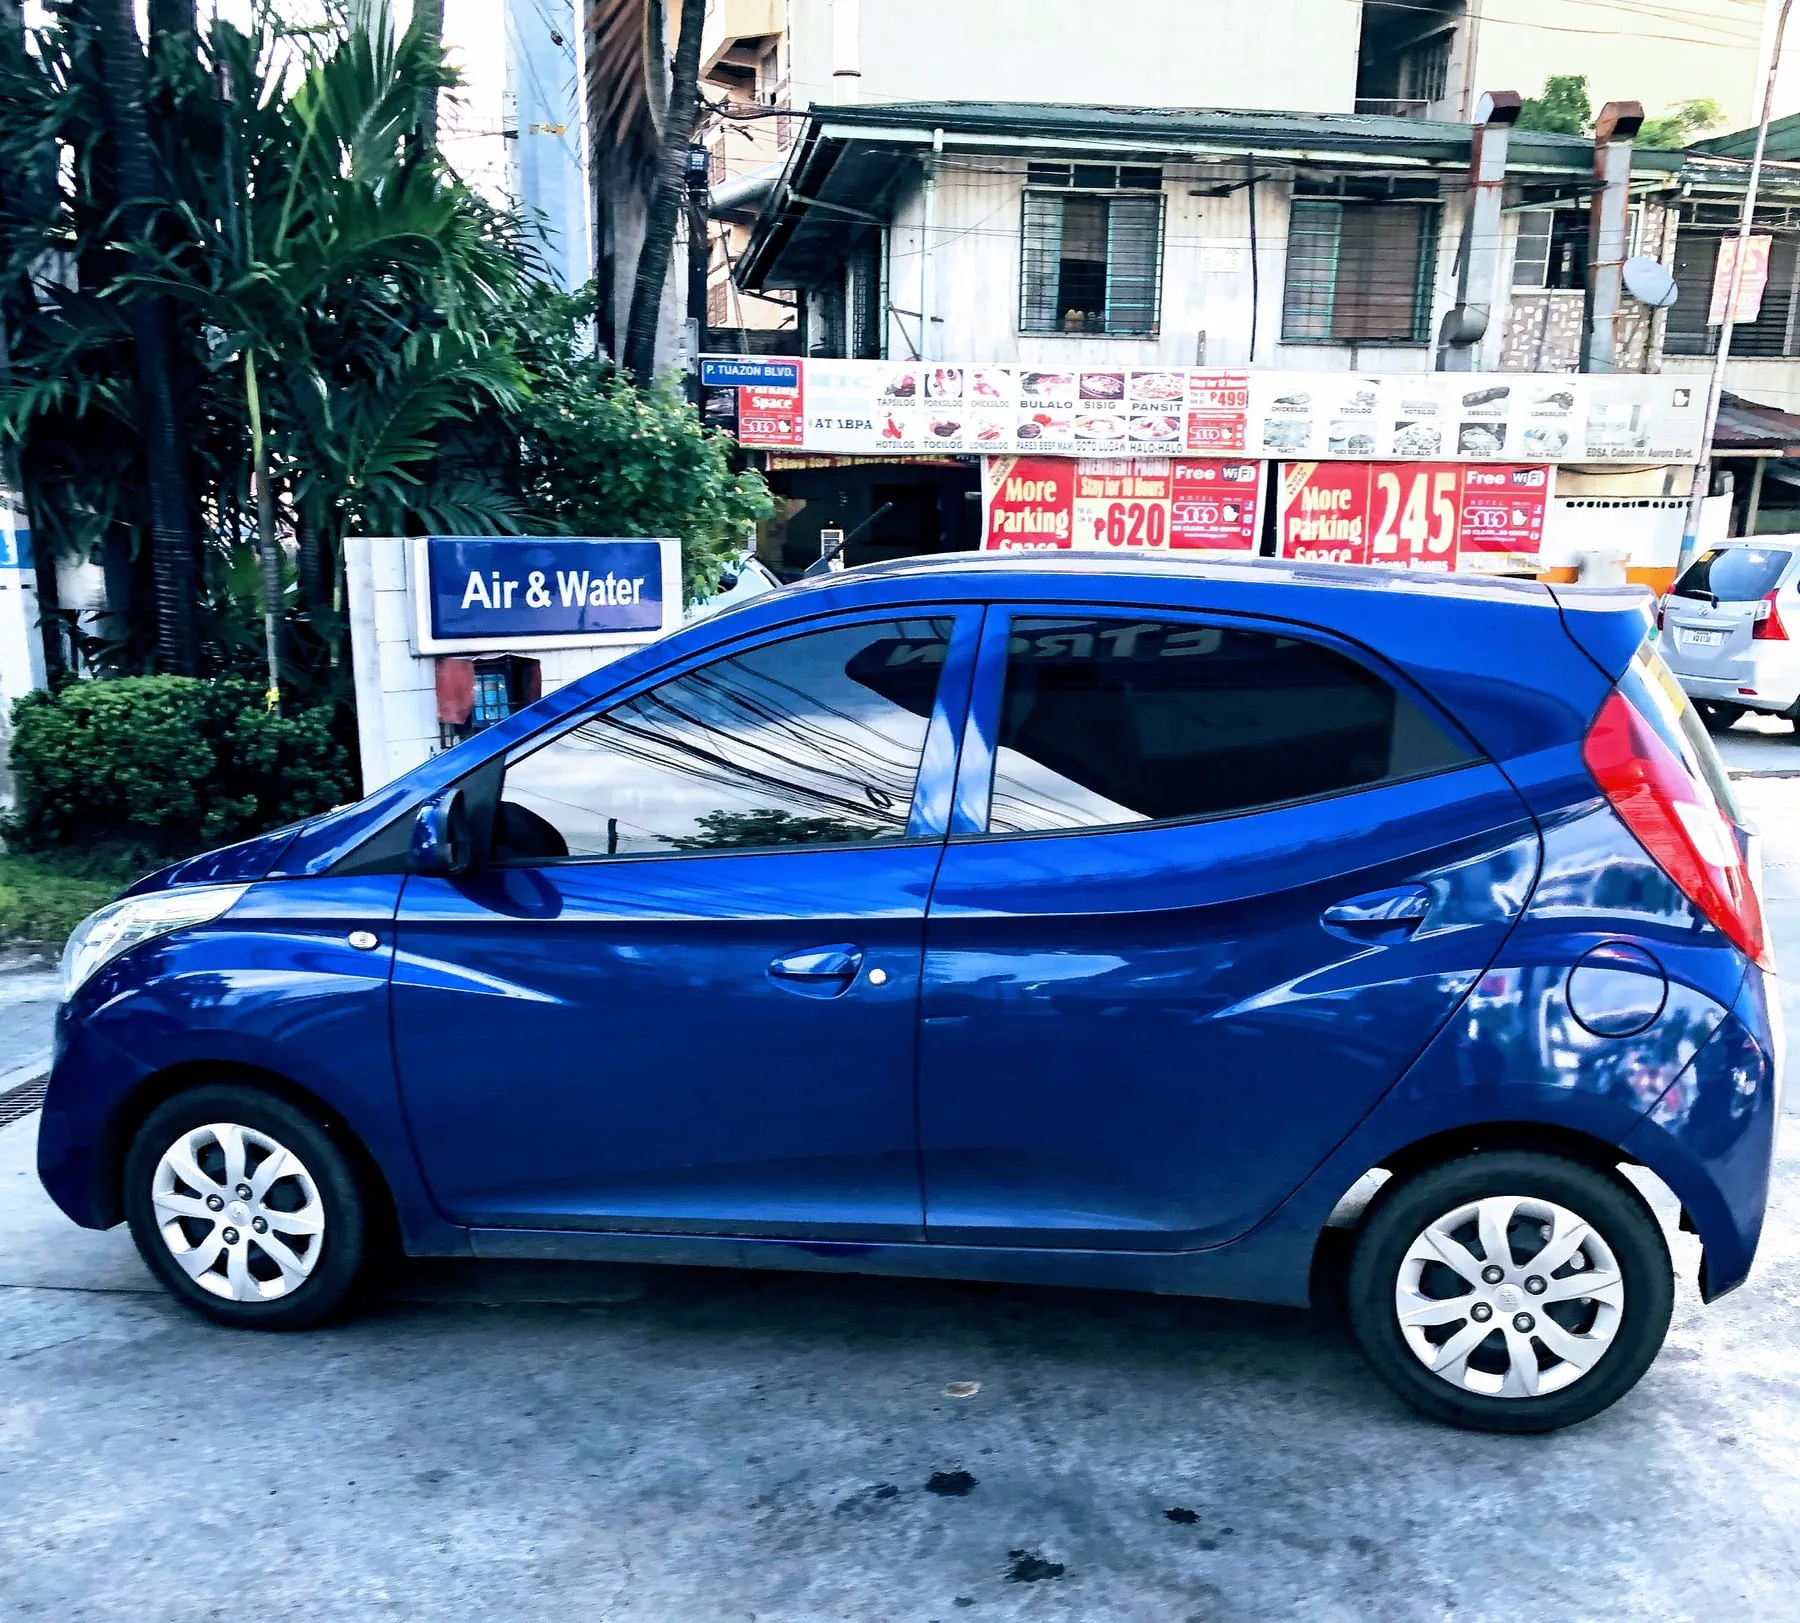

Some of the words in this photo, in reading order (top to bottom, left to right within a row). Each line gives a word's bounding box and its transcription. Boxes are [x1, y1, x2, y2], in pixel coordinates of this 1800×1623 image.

[706, 365, 715, 374] P.
[718, 365, 761, 376] TUAZON
[765, 367, 794, 377] BLVD.
[752, 396, 793, 410] Space
[877, 398, 915, 407] TAPSILOG
[1020, 400, 1073, 409] BULALO
[1084, 401, 1117, 410] SISIG
[1131, 403, 1183, 412] PANSIT
[876, 440, 915, 449] HOTSILOG
[923, 441, 963, 449] TOCILOG
[1130, 443, 1183, 454] HALO-HALO
[1648, 449, 1674, 458] Aurora
[1175, 465, 1216, 481] Free
[1466, 470, 1506, 485] Free
[1004, 477, 1057, 502] More
[1301, 486, 1352, 511] More
[1373, 472, 1457, 554] 245
[993, 506, 1069, 539] Parking
[1289, 513, 1362, 546] Parking
[461, 570, 519, 609] Air
[525, 570, 552, 609] &
[556, 570, 644, 608] Water
